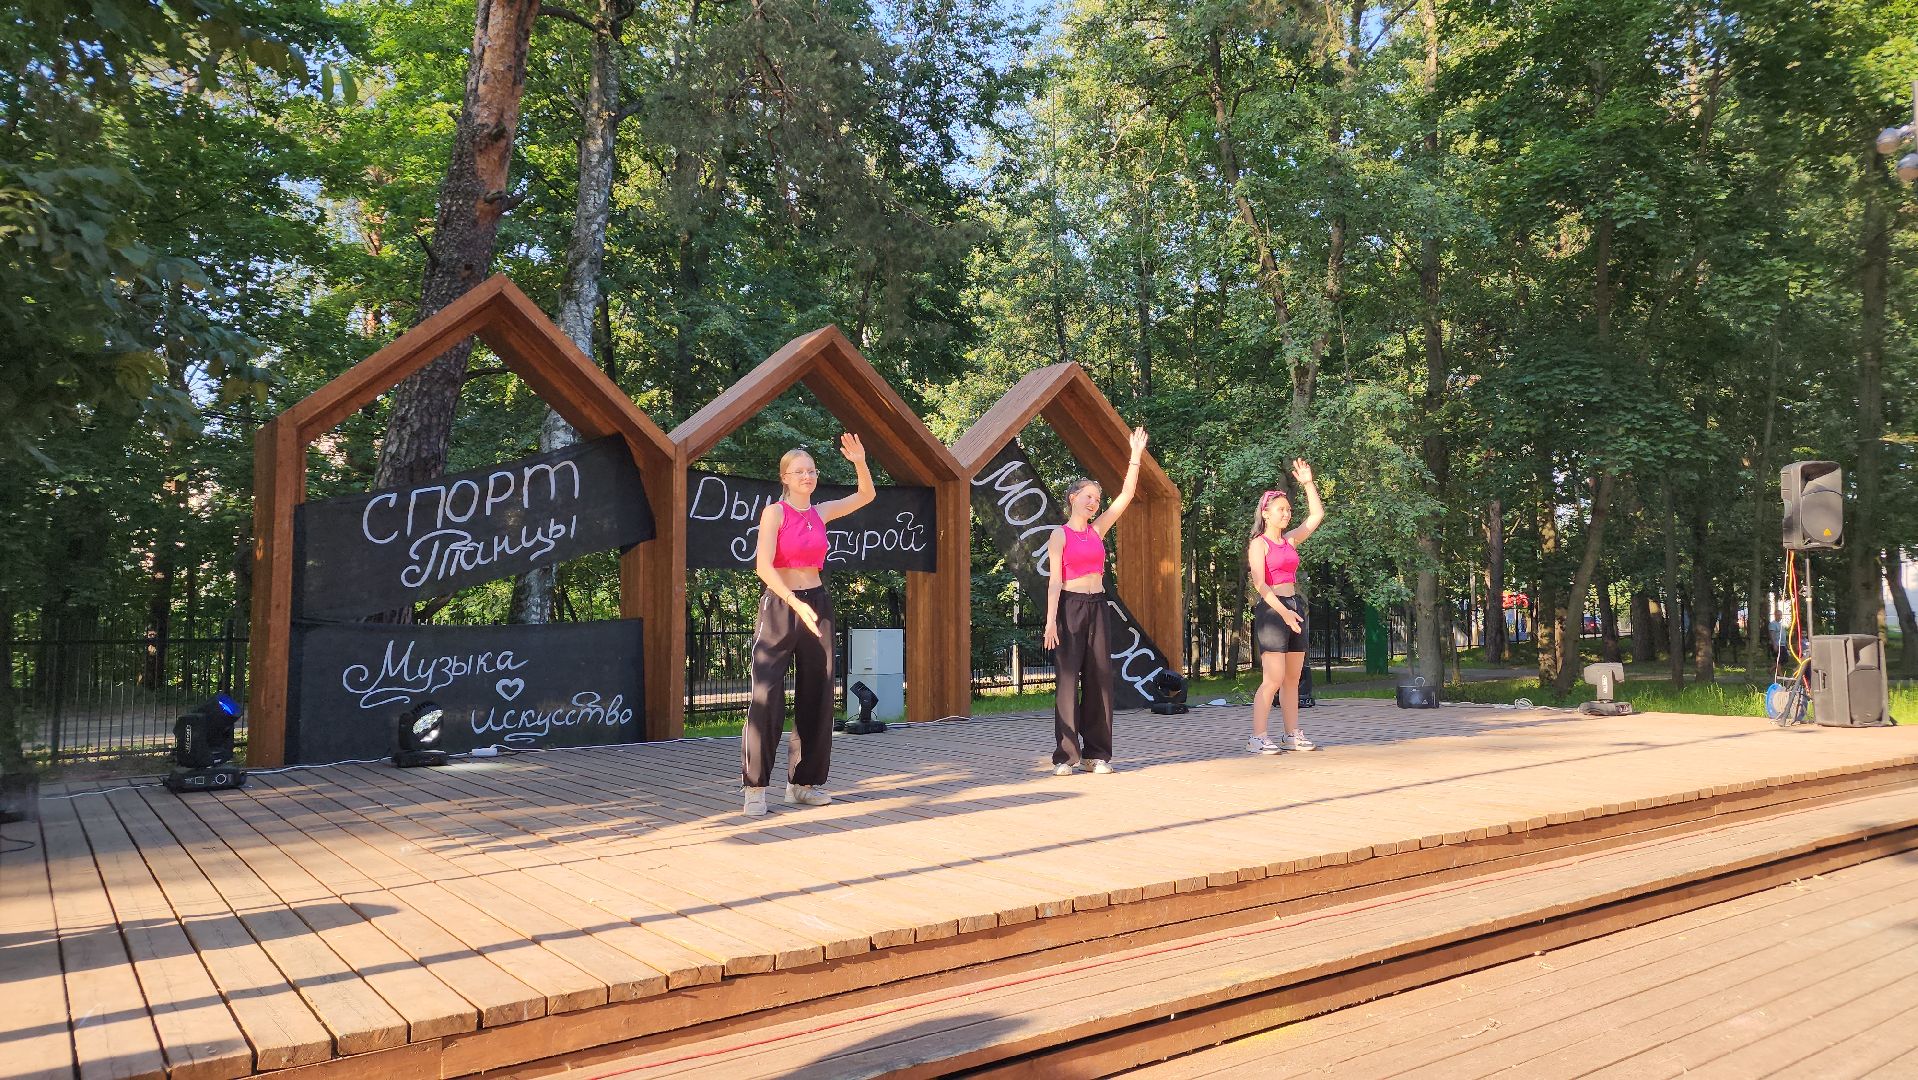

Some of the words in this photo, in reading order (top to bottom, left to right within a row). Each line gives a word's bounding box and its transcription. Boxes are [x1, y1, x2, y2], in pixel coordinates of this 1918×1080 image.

[689, 476, 820, 521] Ды
[400, 515, 577, 588] Танцы
[342, 640, 528, 709] Музыка
